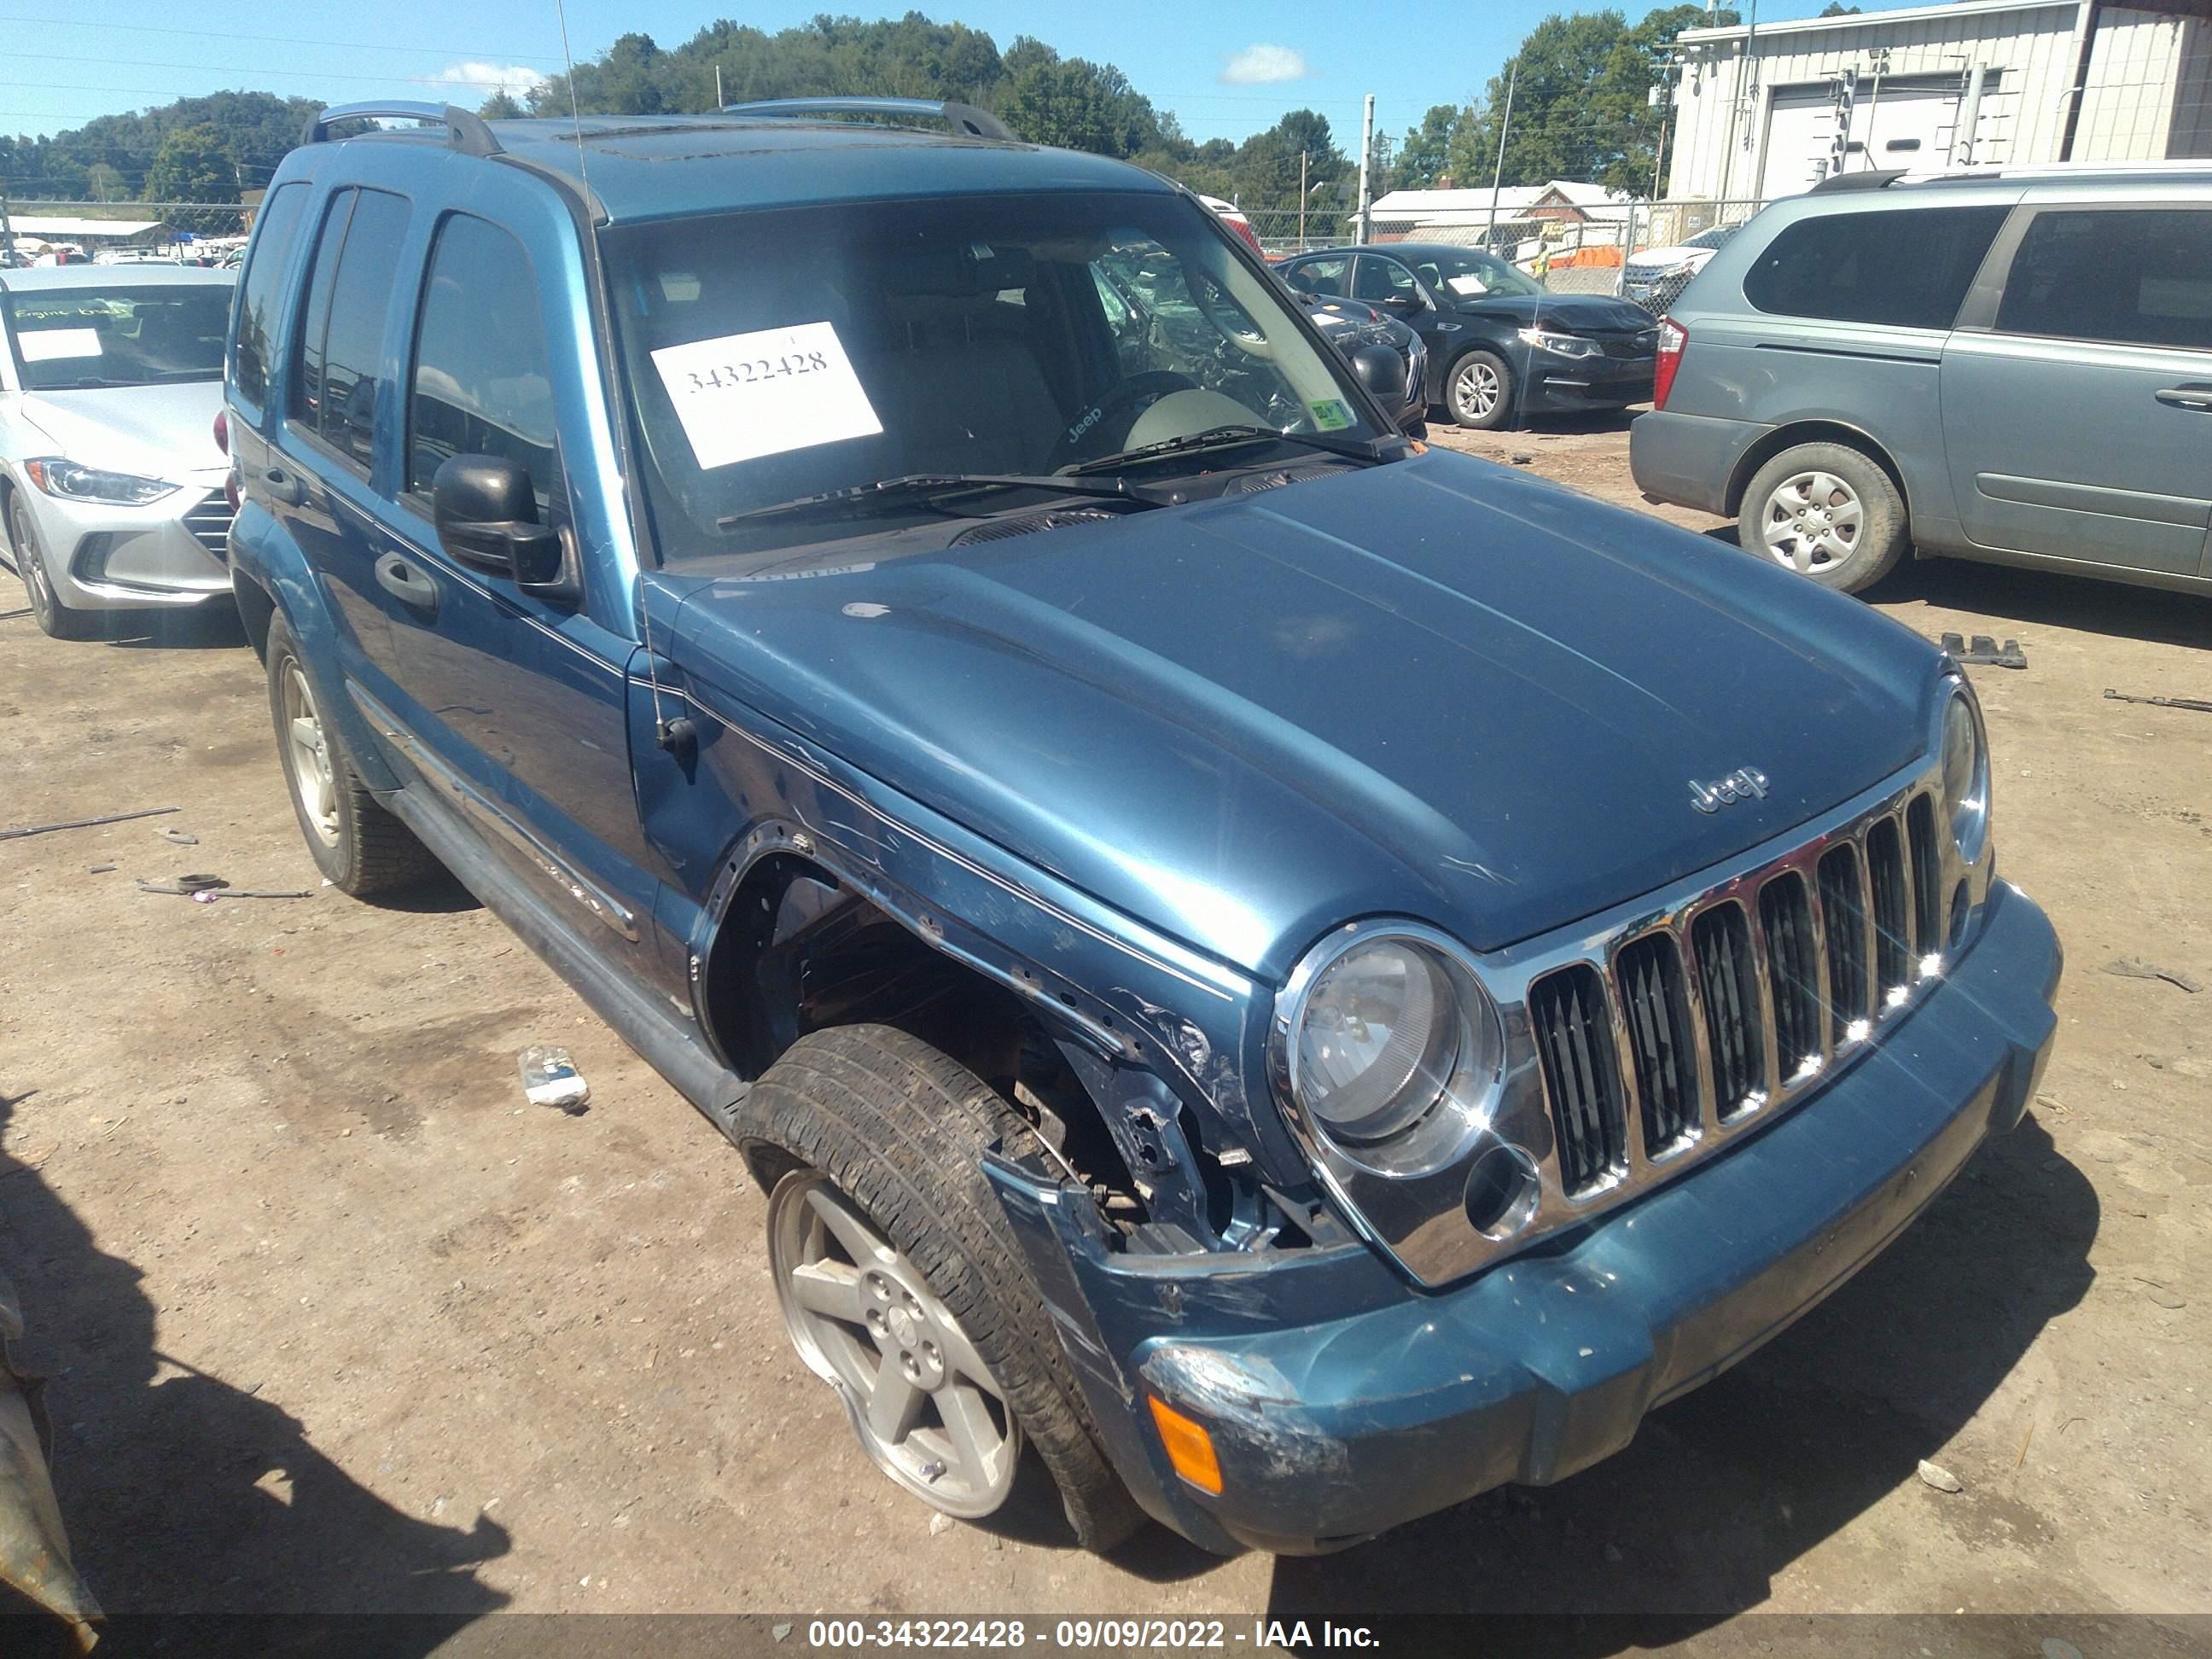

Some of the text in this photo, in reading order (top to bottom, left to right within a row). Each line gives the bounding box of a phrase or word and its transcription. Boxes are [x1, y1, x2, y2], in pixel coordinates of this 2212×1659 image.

[688, 352, 827, 393] 34322428
[1069, 408, 1102, 444] Jeep
[1688, 766, 1769, 813] Jeep
